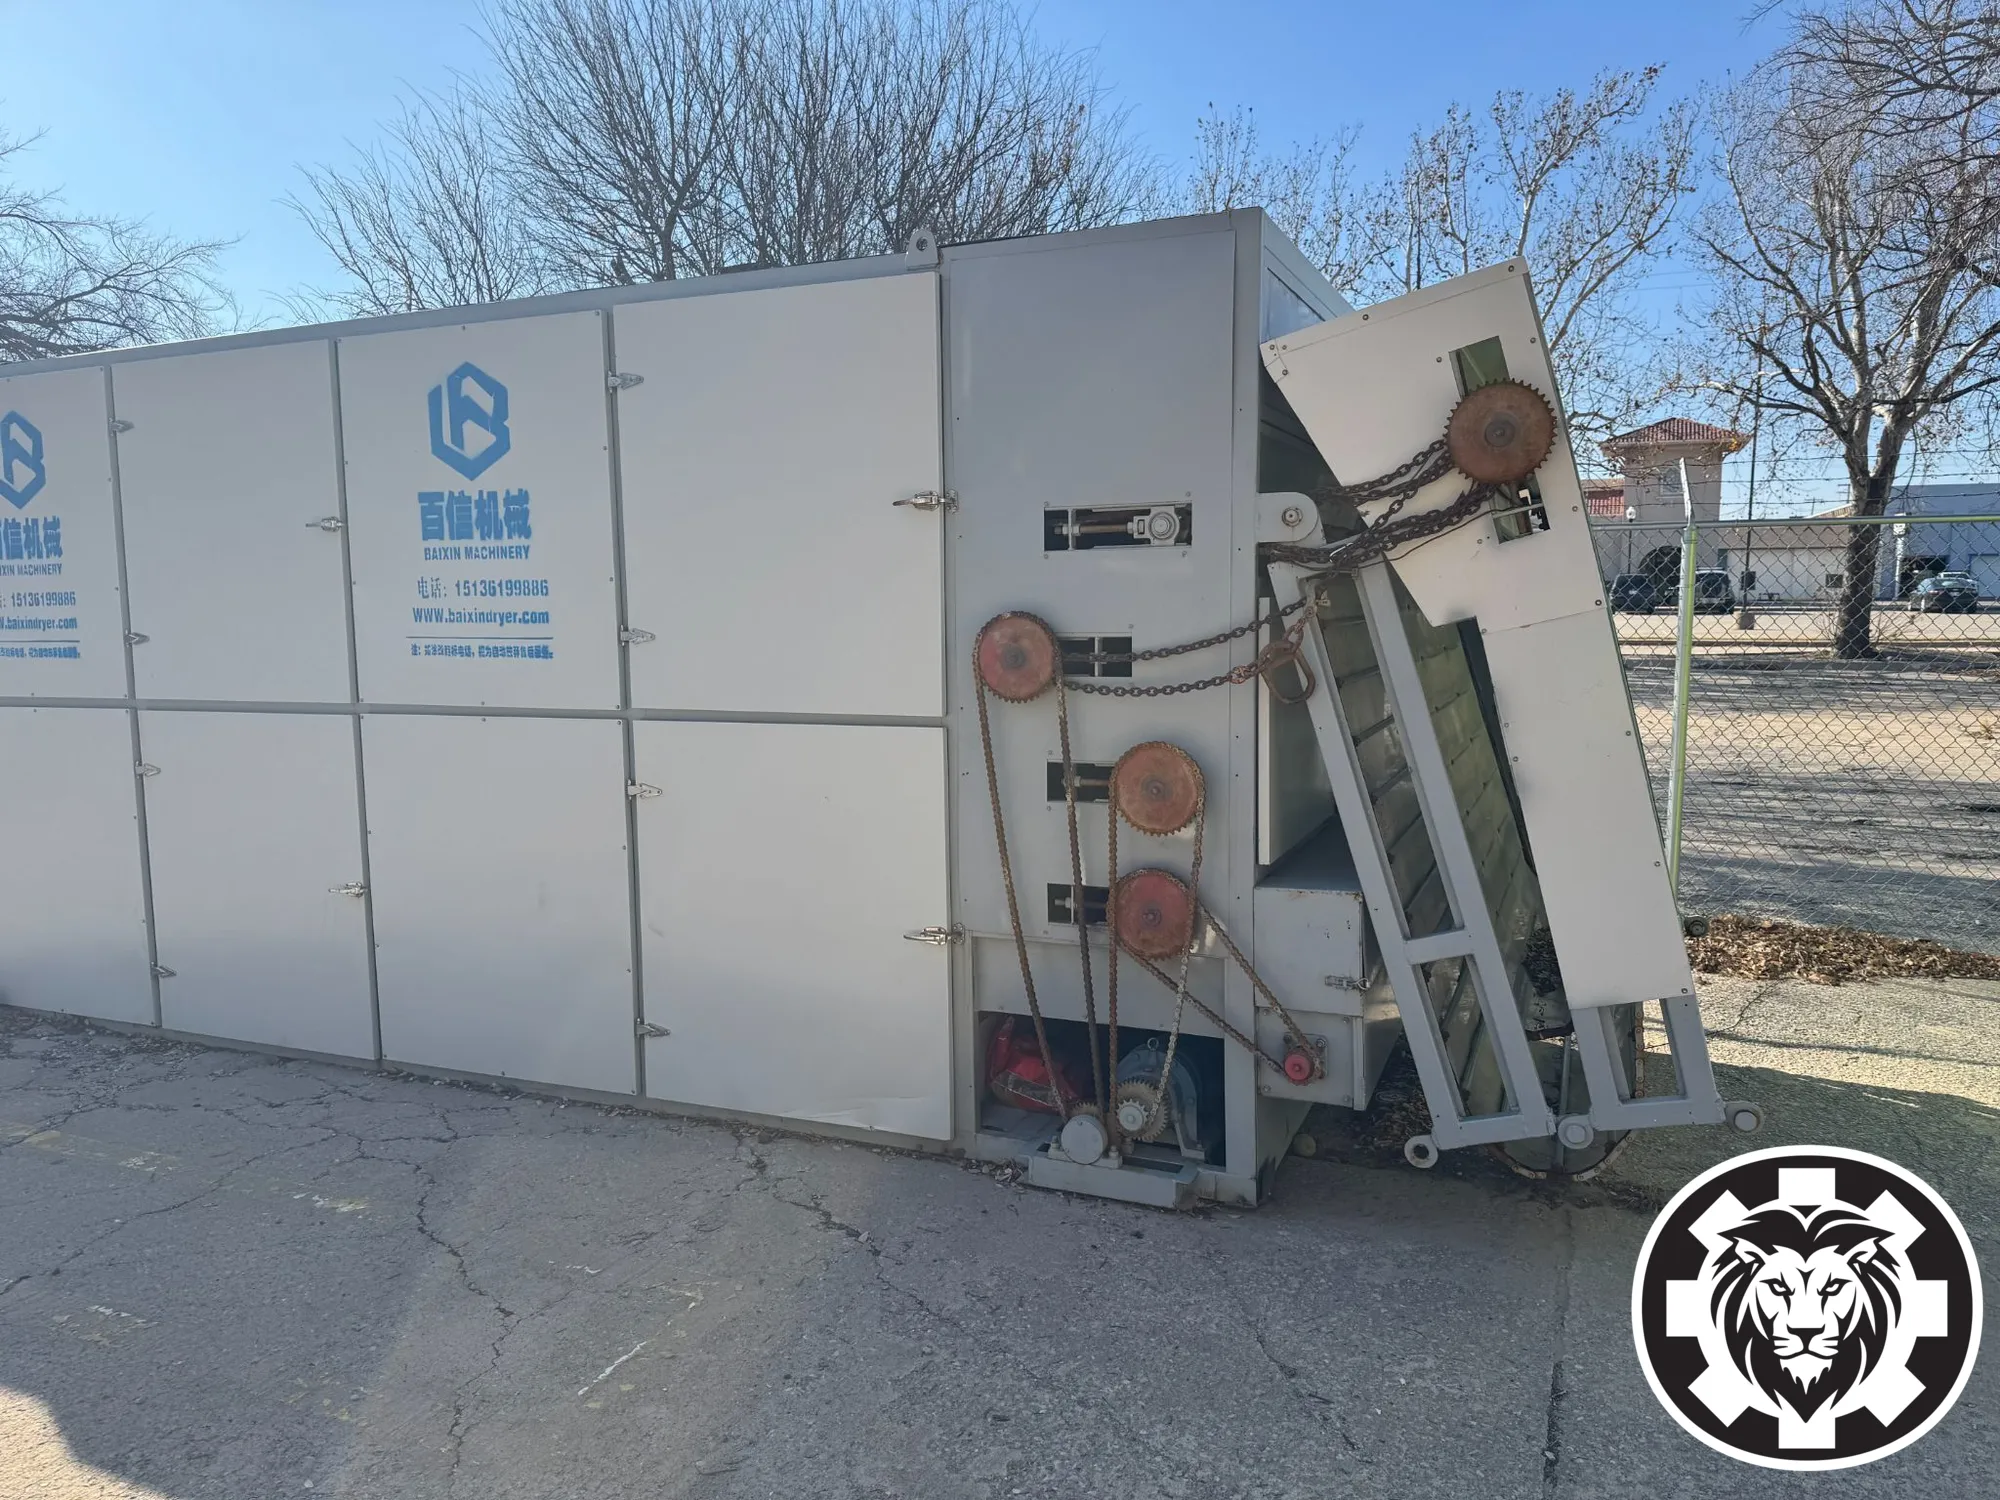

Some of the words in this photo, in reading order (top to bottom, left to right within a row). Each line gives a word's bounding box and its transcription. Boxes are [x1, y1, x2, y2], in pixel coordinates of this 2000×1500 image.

[418, 488, 532, 541] 百信机械
[0, 515, 63, 560] 信机械
[424, 547, 461, 561] BAIXIN
[464, 545, 530, 560] MACHINERY
[17, 563, 62, 576] MACHINERY
[455, 579, 549, 597] 15136199886
